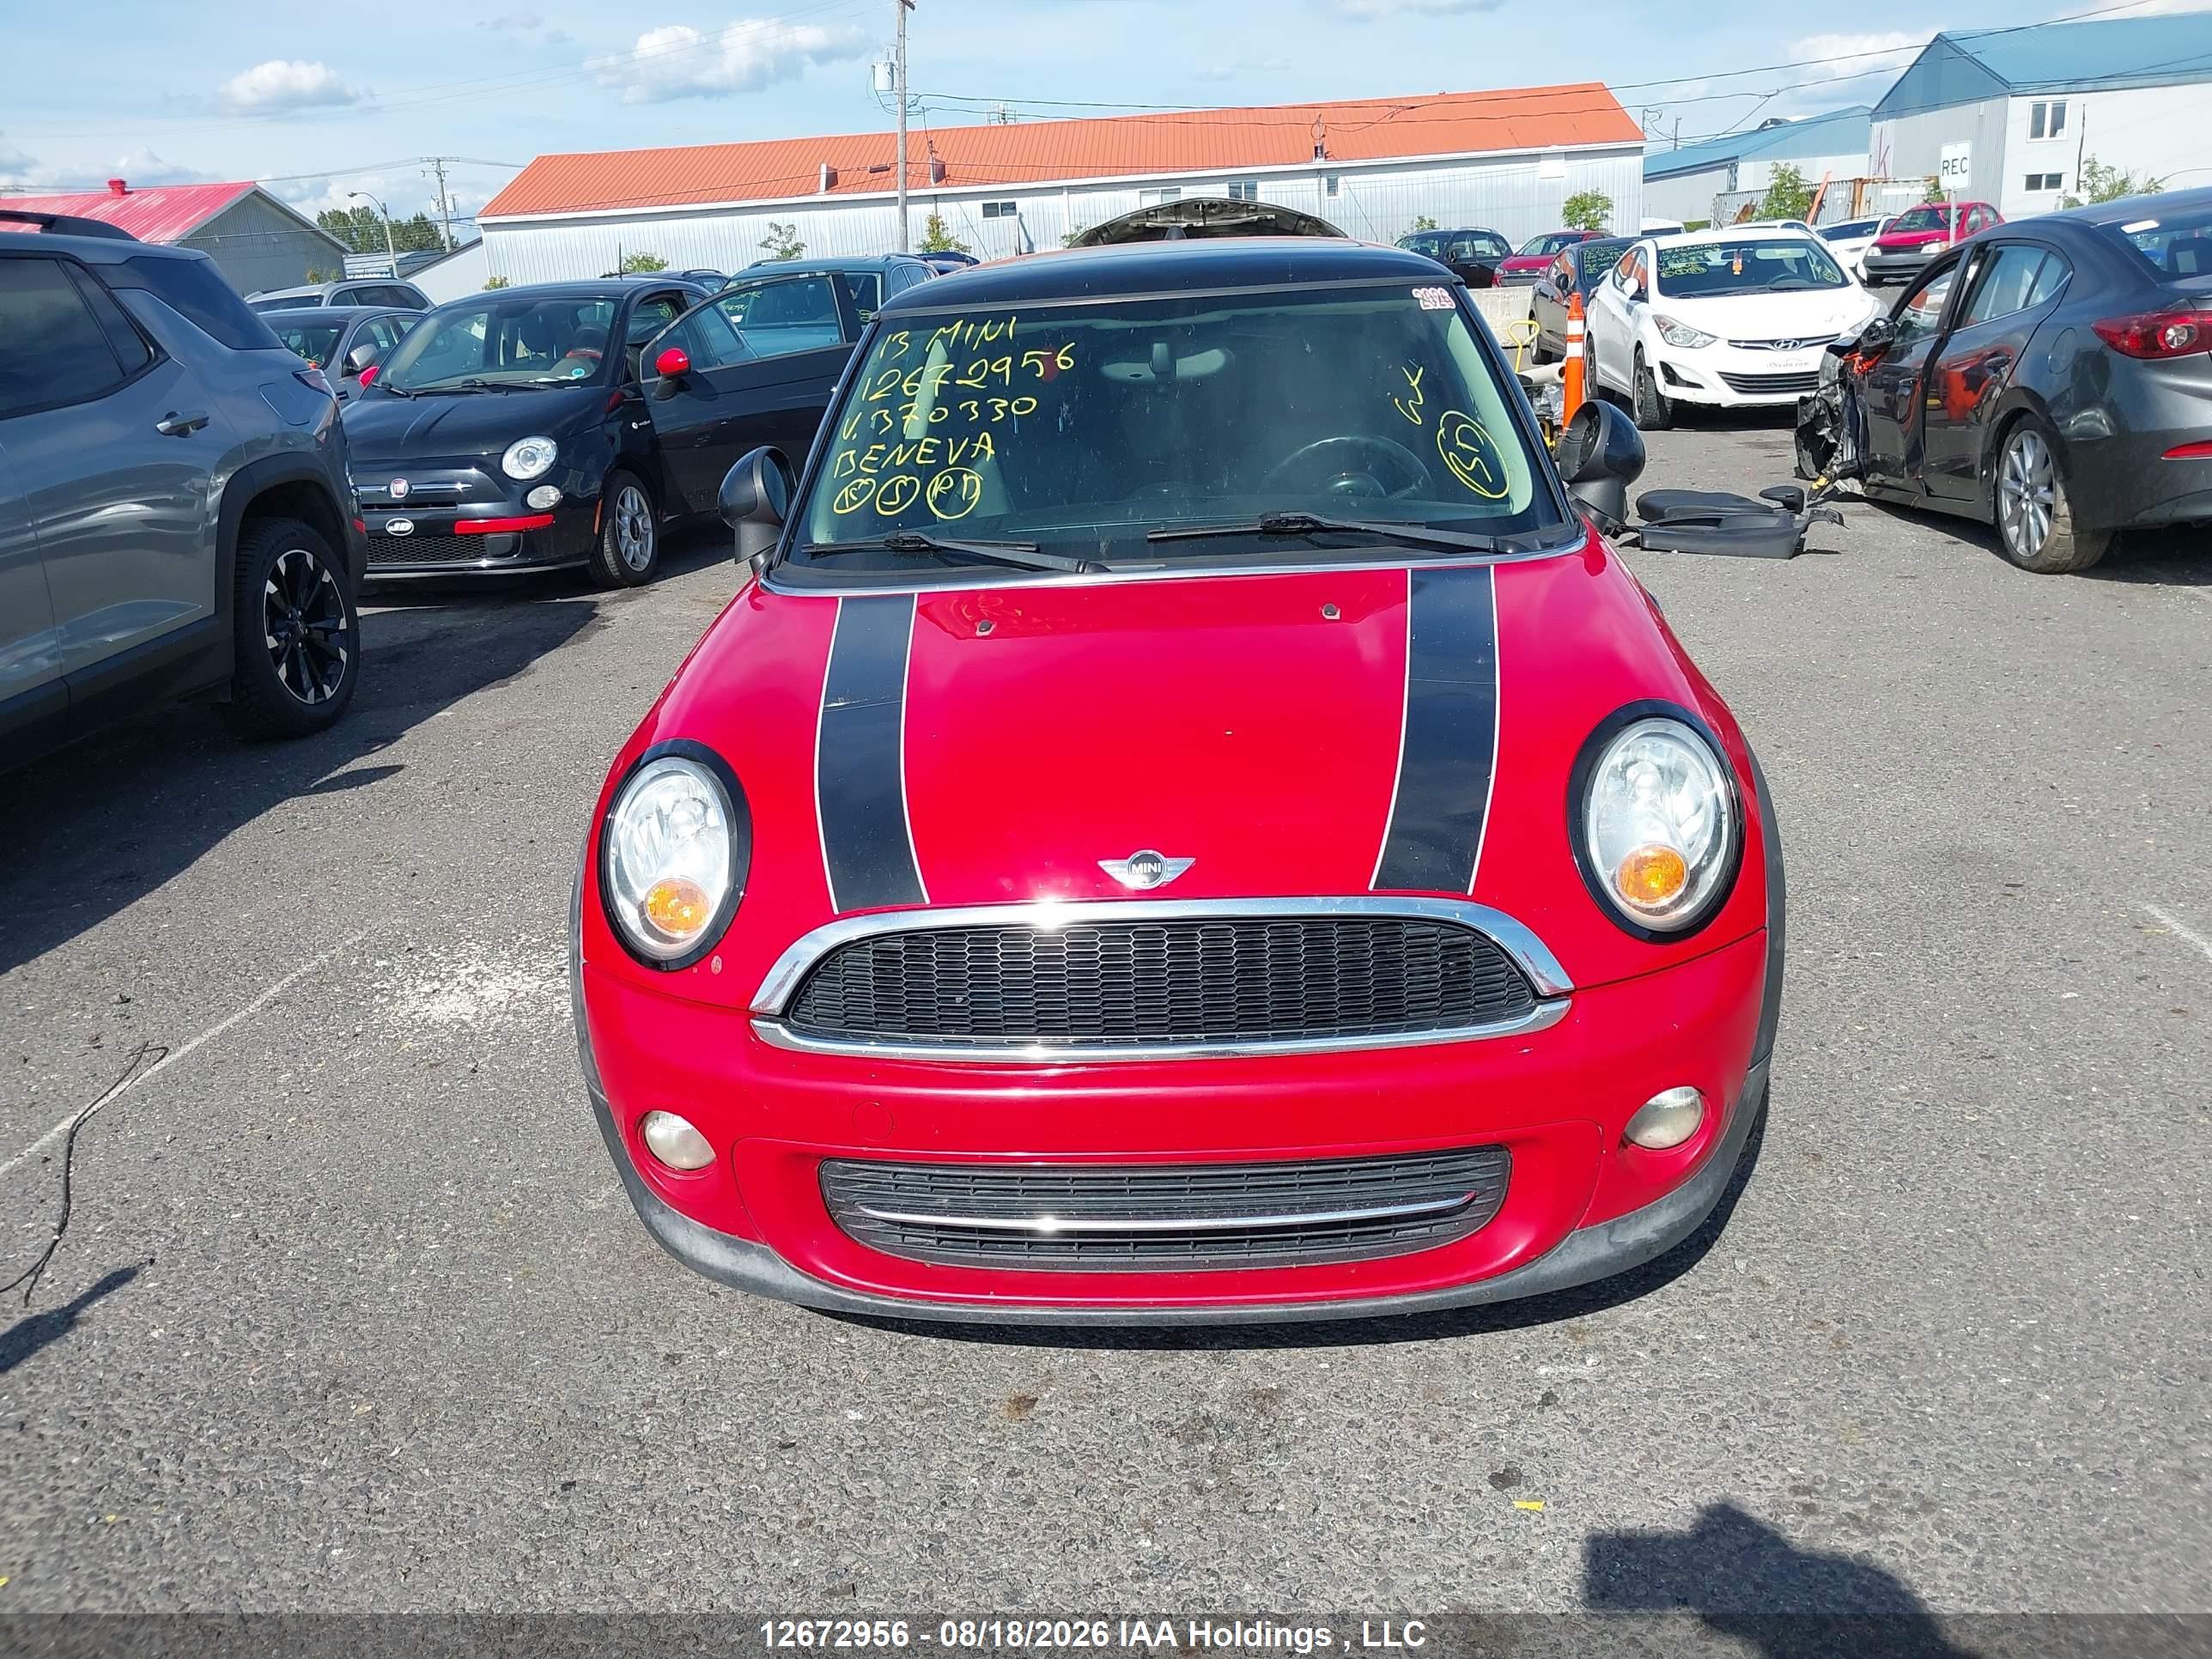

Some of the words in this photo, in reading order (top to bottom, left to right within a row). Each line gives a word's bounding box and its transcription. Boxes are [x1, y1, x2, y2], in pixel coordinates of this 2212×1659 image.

[1941, 156, 1968, 177] REC
[925, 315, 1018, 353] MINI
[860, 341, 1077, 402] 12672956
[833, 431, 996, 479] BENEVA
[1131, 862, 1162, 874] MINI
